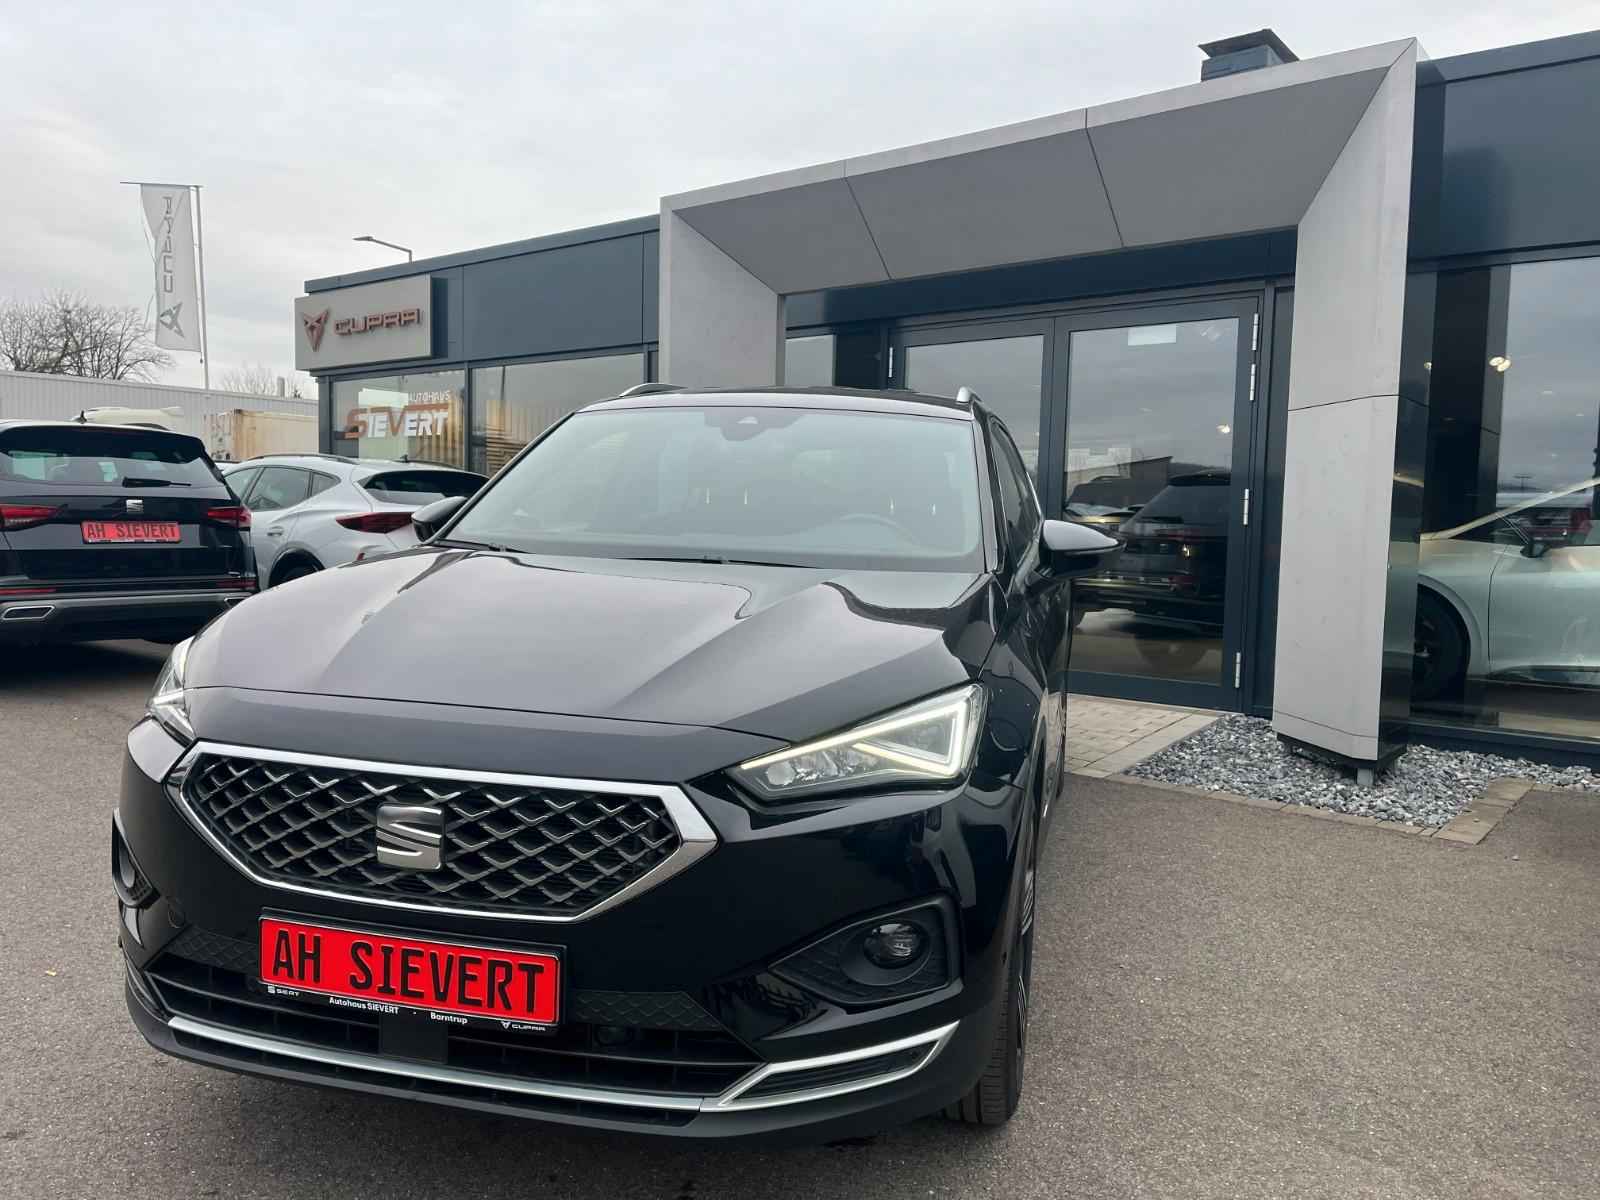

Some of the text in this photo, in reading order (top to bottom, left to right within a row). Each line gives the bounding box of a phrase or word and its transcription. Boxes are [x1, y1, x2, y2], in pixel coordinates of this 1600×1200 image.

[333, 308, 422, 335] CUPRA
[408, 390, 450, 402] AUTOHAUS
[87, 523, 177, 538] AH SIEVERT
[272, 928, 545, 1013] AH SIEVERT
[276, 988, 300, 997] SEAT
[329, 996, 468, 1025] Autohaus SIEVERT Barntrup
[511, 1023, 546, 1031] CUPRA
